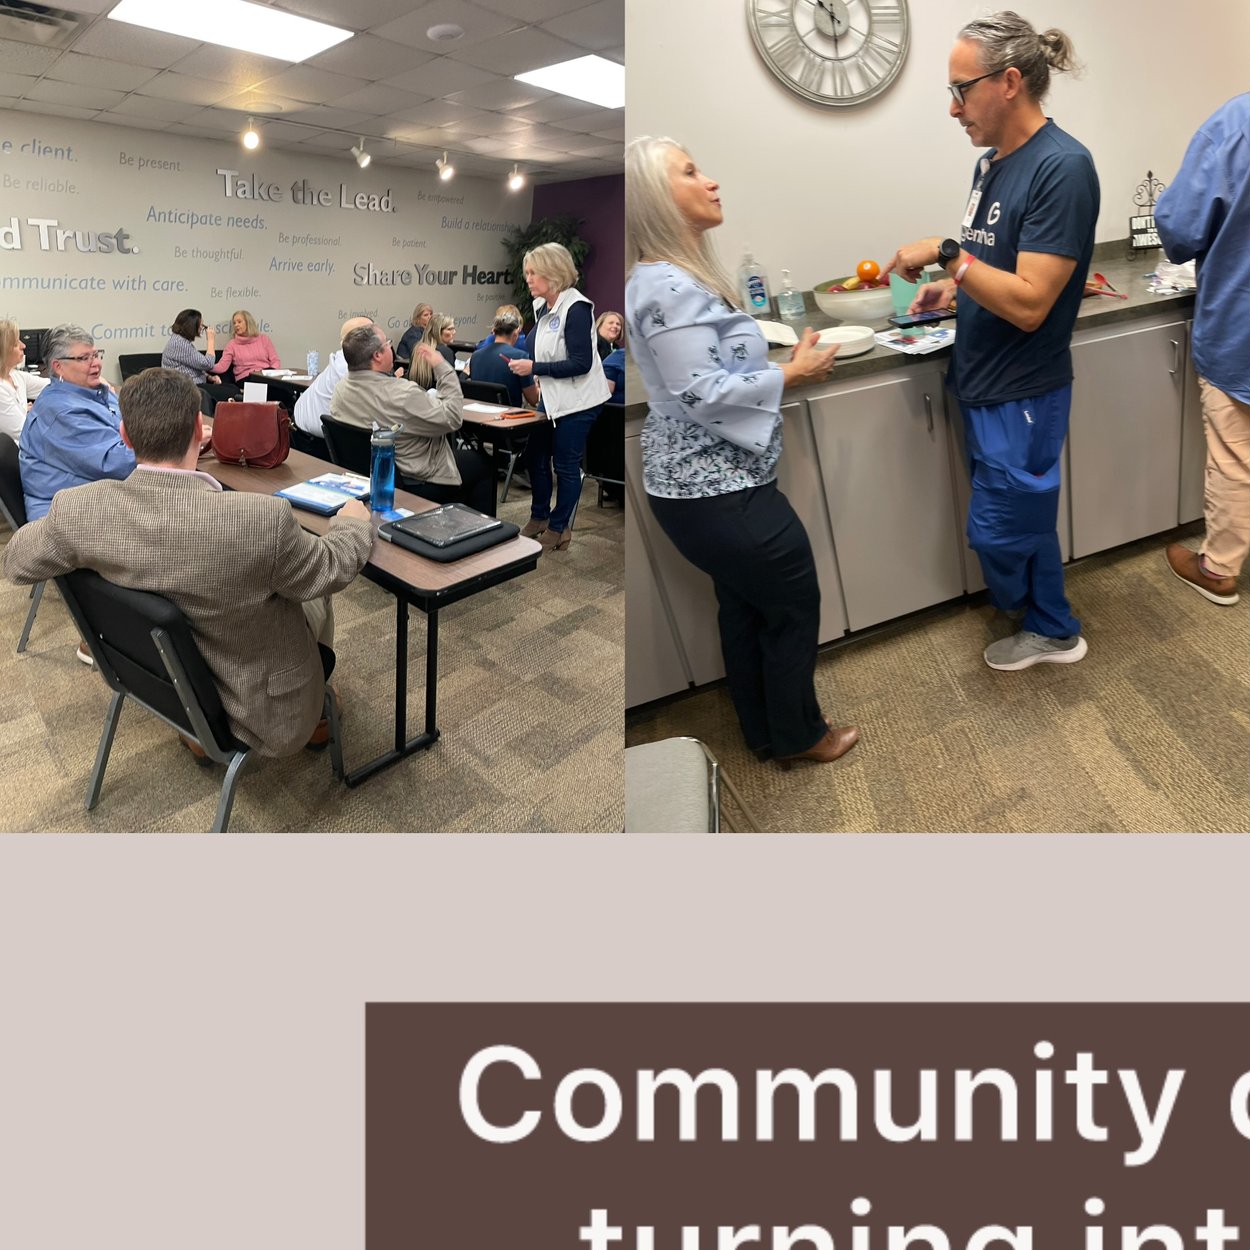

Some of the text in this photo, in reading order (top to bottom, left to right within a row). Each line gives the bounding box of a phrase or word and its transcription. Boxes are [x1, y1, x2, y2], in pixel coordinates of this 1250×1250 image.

[20, 138, 78, 162] client.
[119, 151, 134, 166] Be
[3, 174, 79, 195] Be reliable.
[216, 168, 397, 213] Take the Lead.
[146, 205, 267, 230] Anticipate needs.
[441, 216, 463, 230] Build
[464, 221, 470, 231] a
[27, 217, 140, 254] Trust.
[279, 232, 290, 244] Be
[392, 237, 400, 247] Be
[174, 246, 188, 258] Be
[269, 256, 335, 276] Arrive early.
[353, 262, 515, 286] Share Your Heart.
[112, 275, 147, 292] with
[152, 279, 189, 292] care.
[210, 287, 223, 298] Be
[339, 309, 348, 319] Be
[387, 316, 400, 329] Go
[92, 323, 155, 340] Commit
